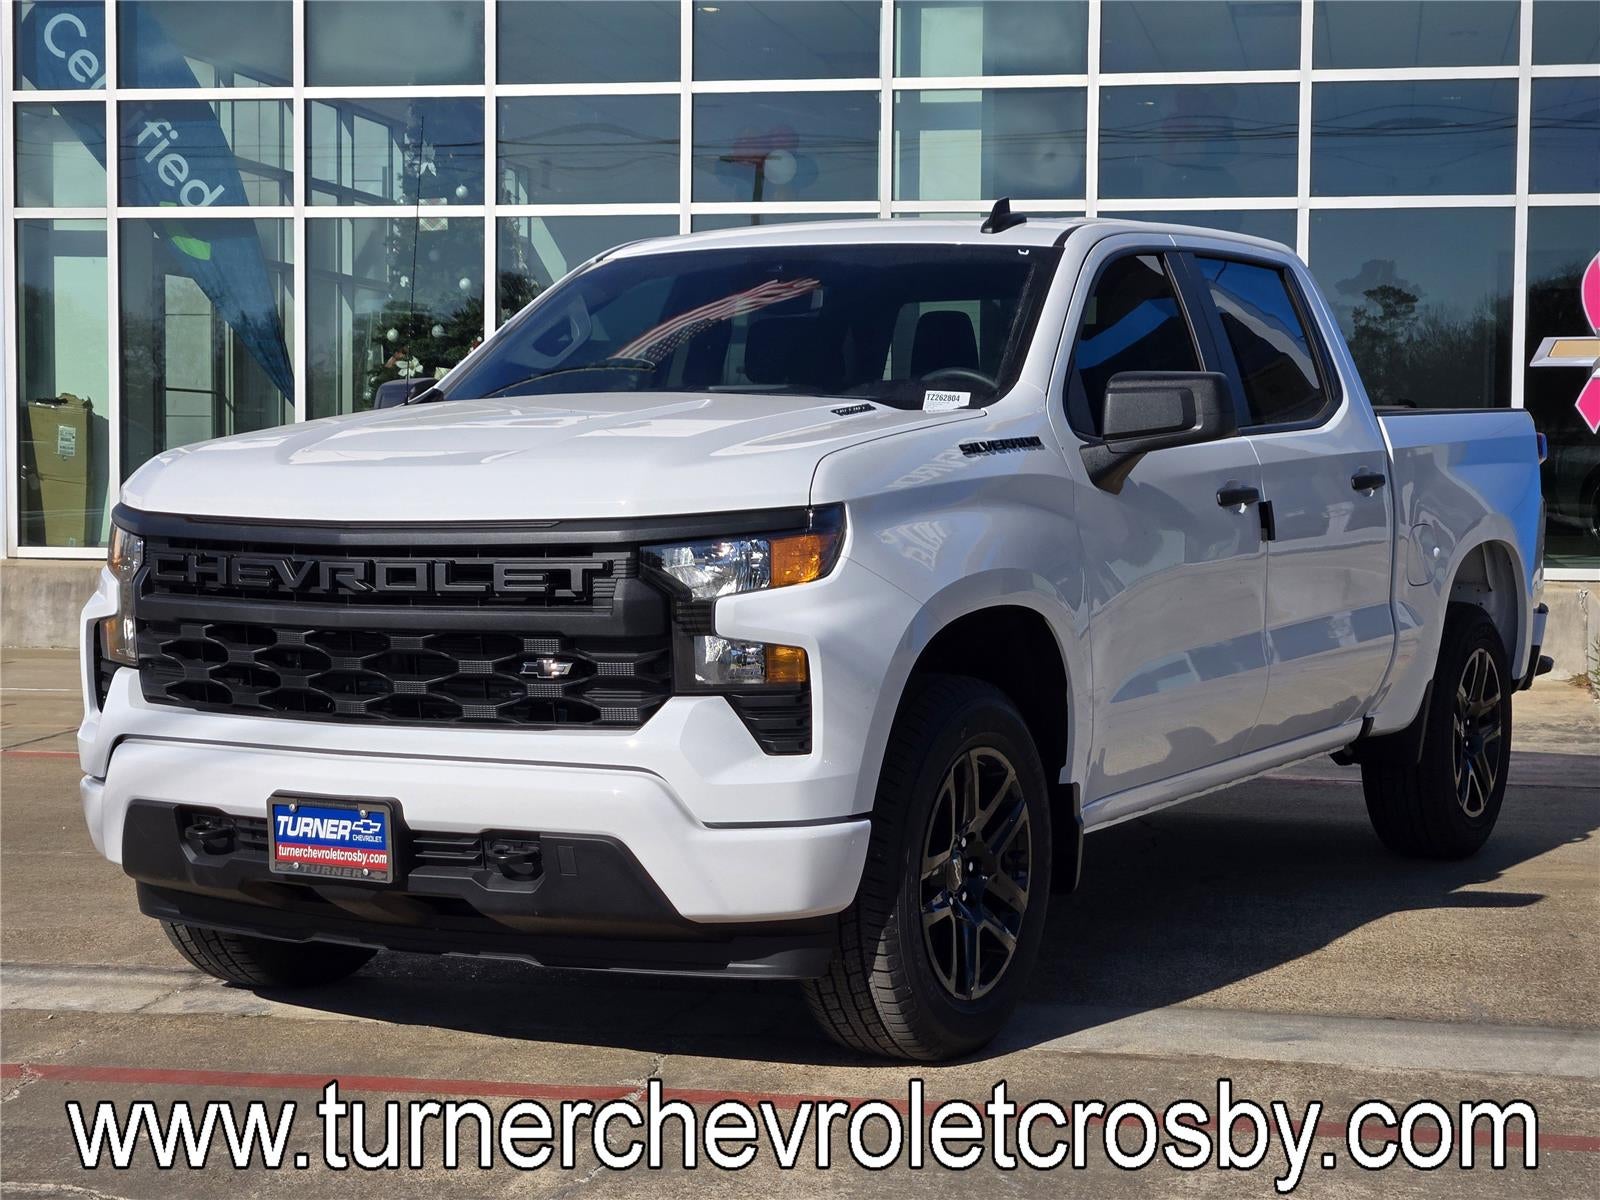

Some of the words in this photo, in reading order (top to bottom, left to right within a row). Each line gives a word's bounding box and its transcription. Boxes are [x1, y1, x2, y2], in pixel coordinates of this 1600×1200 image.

[927, 393, 961, 402] TZ262804
[958, 435, 1043, 456] SILVERADO
[149, 550, 613, 599] CHEVROLET
[277, 815, 352, 841] TURNER
[352, 834, 383, 843] CHEVROLET
[278, 845, 388, 865] turnerchevroletcrosby.com
[301, 864, 363, 878] TURNER
